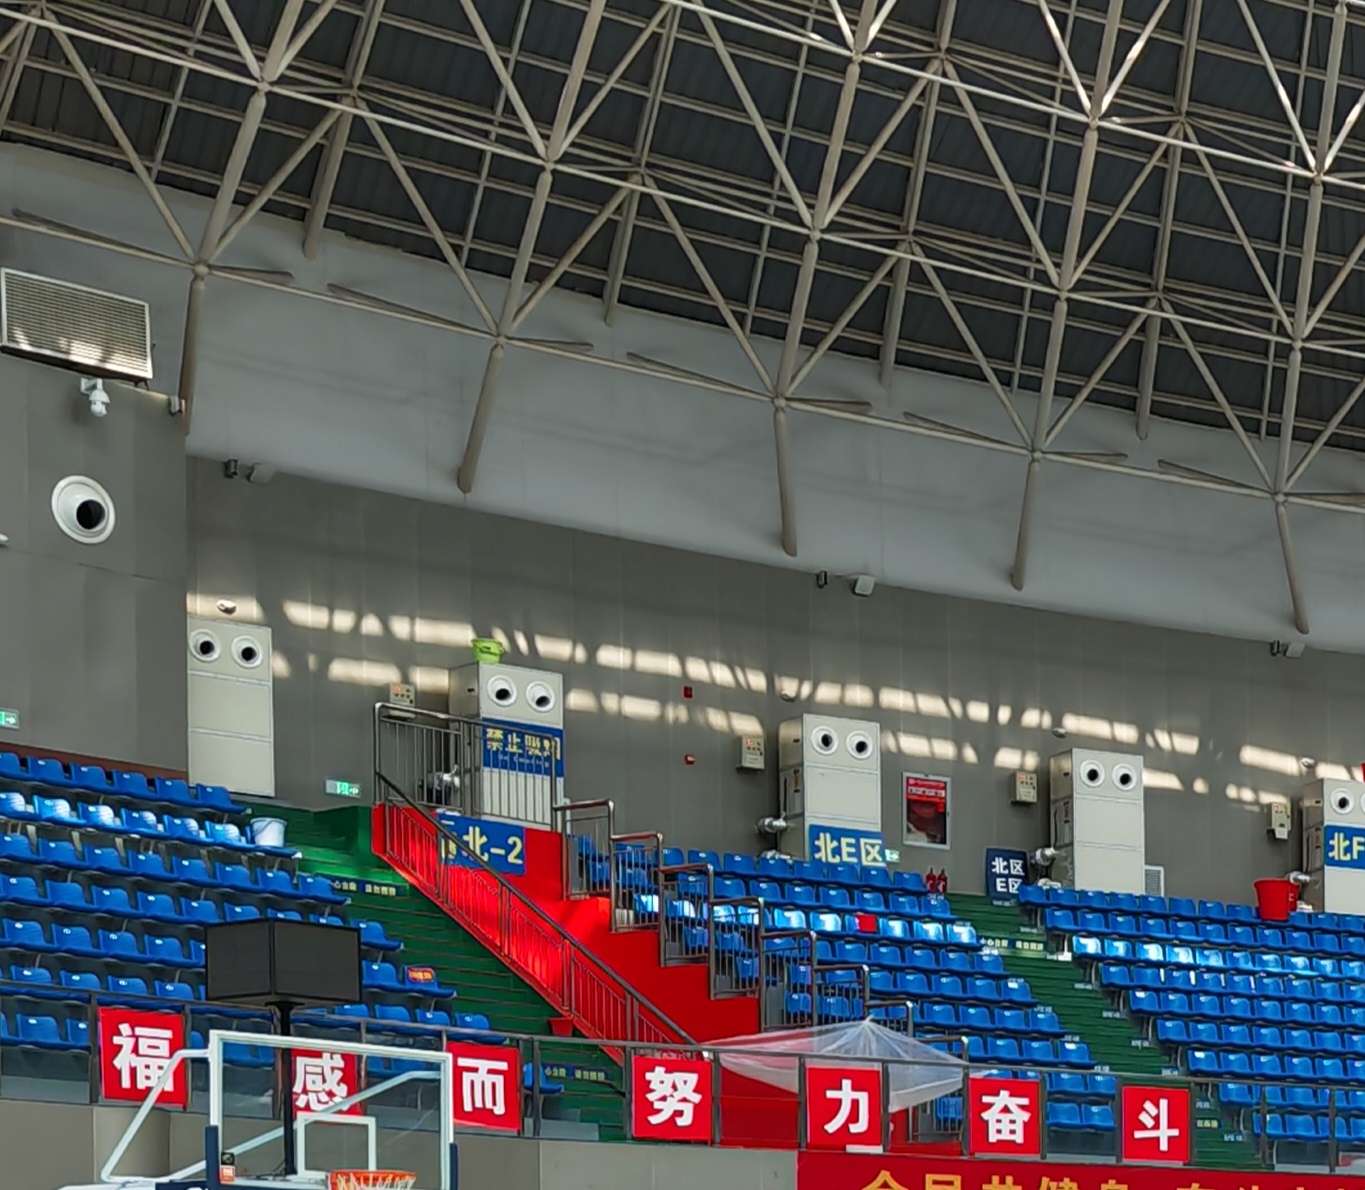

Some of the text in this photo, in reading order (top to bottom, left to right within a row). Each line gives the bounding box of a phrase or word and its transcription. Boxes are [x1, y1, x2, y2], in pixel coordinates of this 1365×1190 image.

[462, 825, 524, 865] 北-2
[812, 831, 885, 867] 北E区
[991, 856, 1025, 876] 北区
[995, 877, 1023, 894] E区
[113, 1022, 1180, 1152] 福 感 而 努 力 奋 斗
